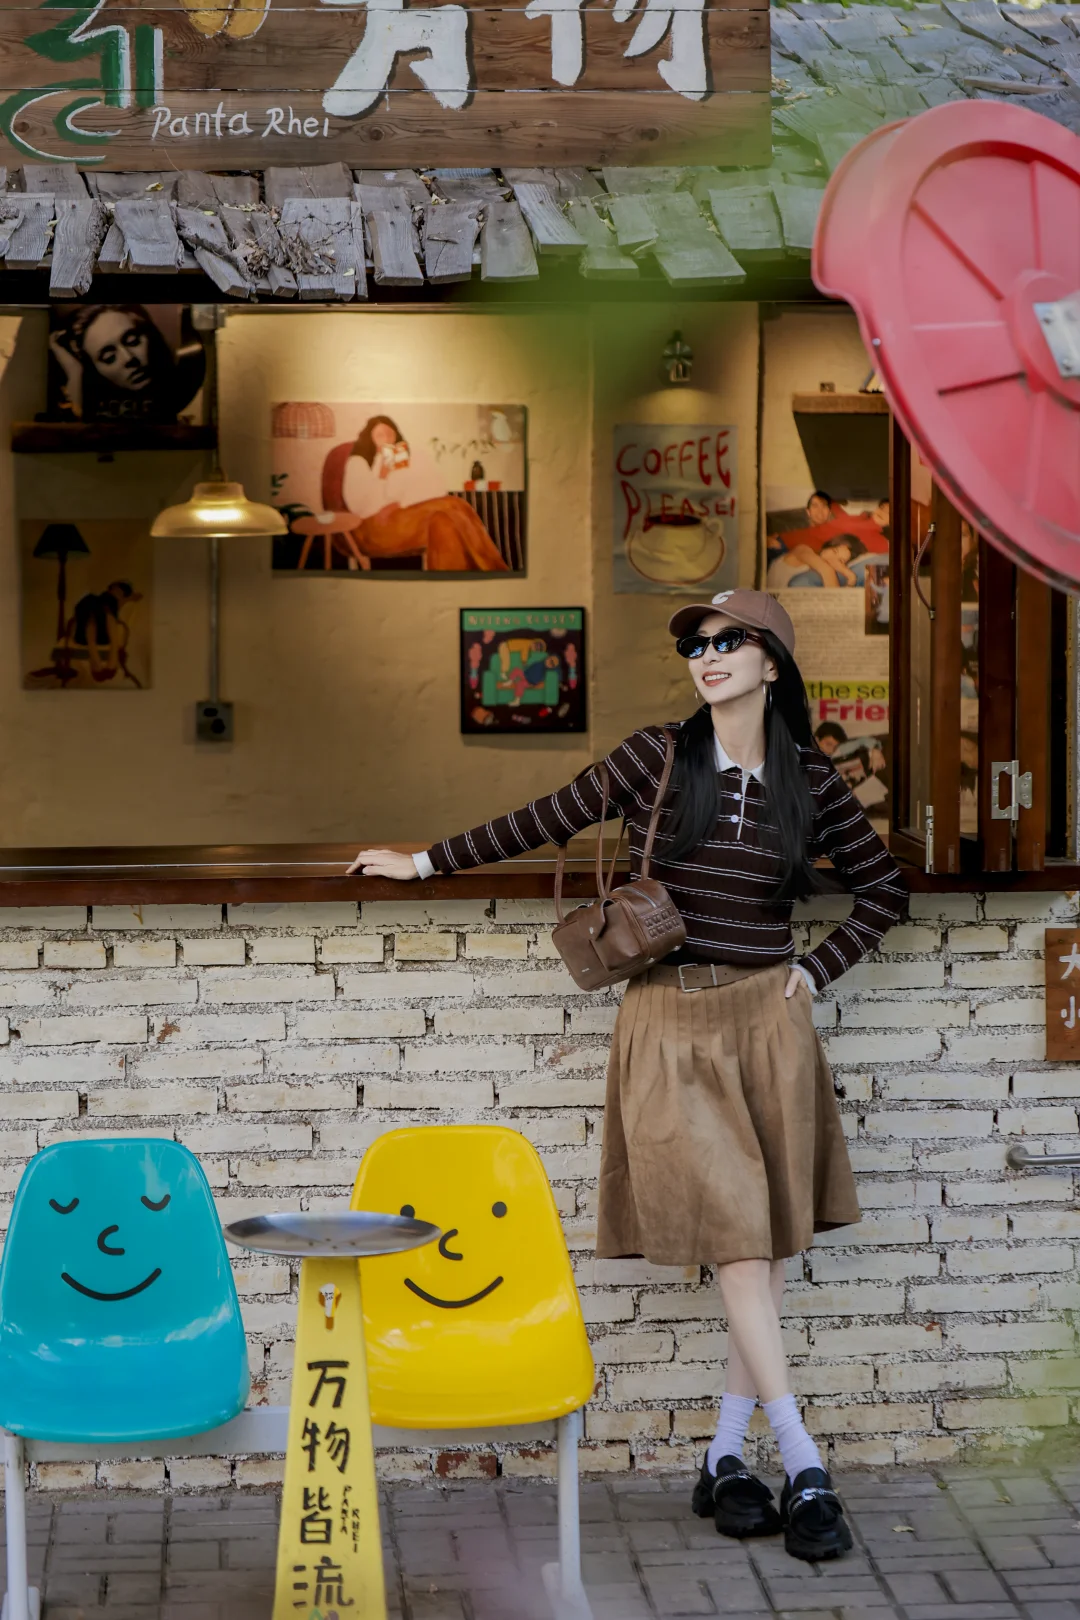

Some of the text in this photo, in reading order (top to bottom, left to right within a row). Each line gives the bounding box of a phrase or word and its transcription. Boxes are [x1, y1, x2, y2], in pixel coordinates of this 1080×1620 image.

[152, 101, 329, 140] Panta Rhei
[616, 430, 730, 489] COFFEE
[809, 680, 850, 700] the
[818, 697, 890, 723] Frie
[292, 1360, 355, 1609] 万物皆流
